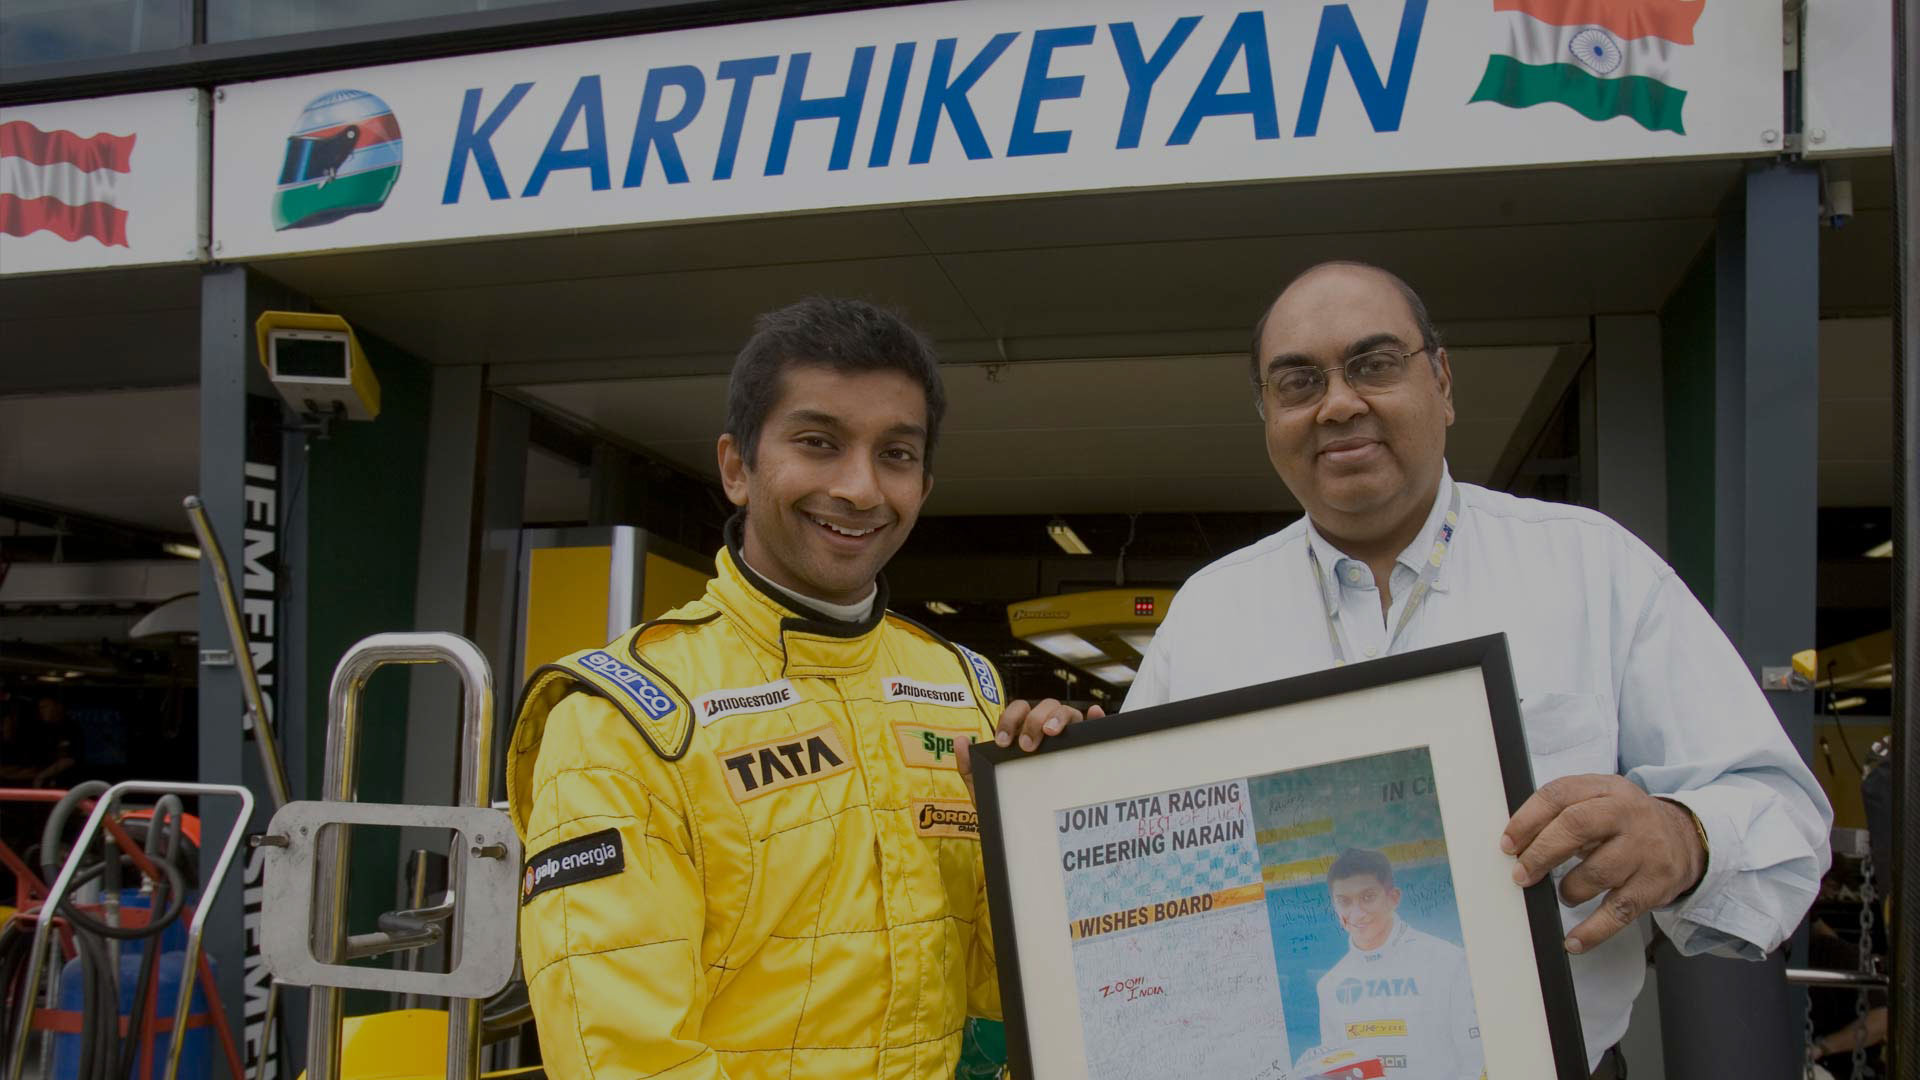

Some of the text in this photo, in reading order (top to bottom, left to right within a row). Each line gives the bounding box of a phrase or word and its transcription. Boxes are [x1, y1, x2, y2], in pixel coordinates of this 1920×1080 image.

[441, 0, 1429, 205] KARTHIKEYAN
[589, 652, 672, 713] sparco
[704, 688, 791, 717] BRIDGESTONE
[891, 682, 965, 703] BRIDGESTONE
[725, 736, 844, 792] TATA
[920, 804, 979, 829] JORDA
[1059, 805, 1108, 833] JOIN
[1115, 796, 1162, 823] TATA
[1168, 783, 1240, 814] RACING
[535, 843, 616, 885] galp energia
[1063, 819, 1244, 872] CHEERING NARAIN
[1079, 893, 1213, 938] WISHES BOARD
[1366, 976, 1418, 998] TATA
